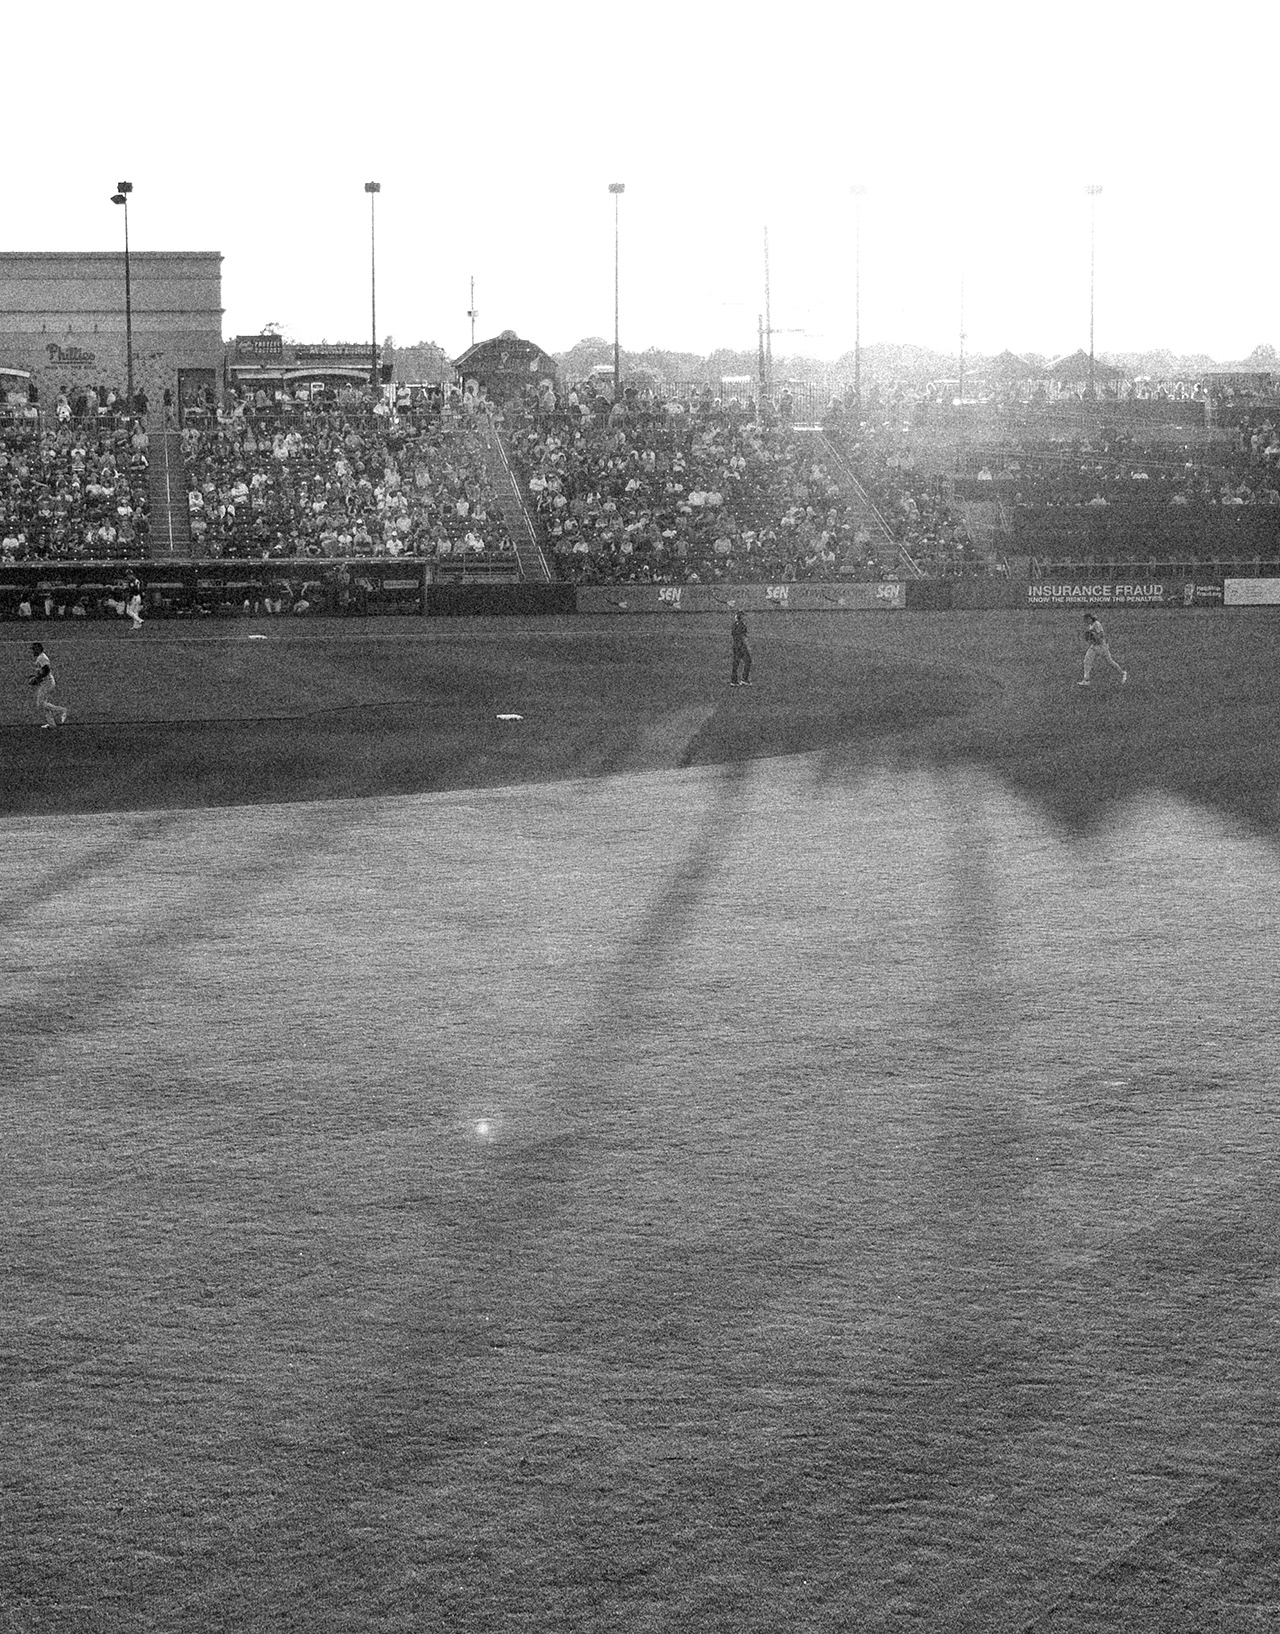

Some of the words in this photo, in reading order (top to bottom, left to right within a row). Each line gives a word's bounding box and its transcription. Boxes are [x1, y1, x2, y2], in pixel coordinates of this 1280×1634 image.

[658, 588, 681, 601] SEN
[765, 586, 789, 600] SEN
[1028, 585, 1111, 596] INSURANCE
[1115, 584, 1163, 596] FRAUD
